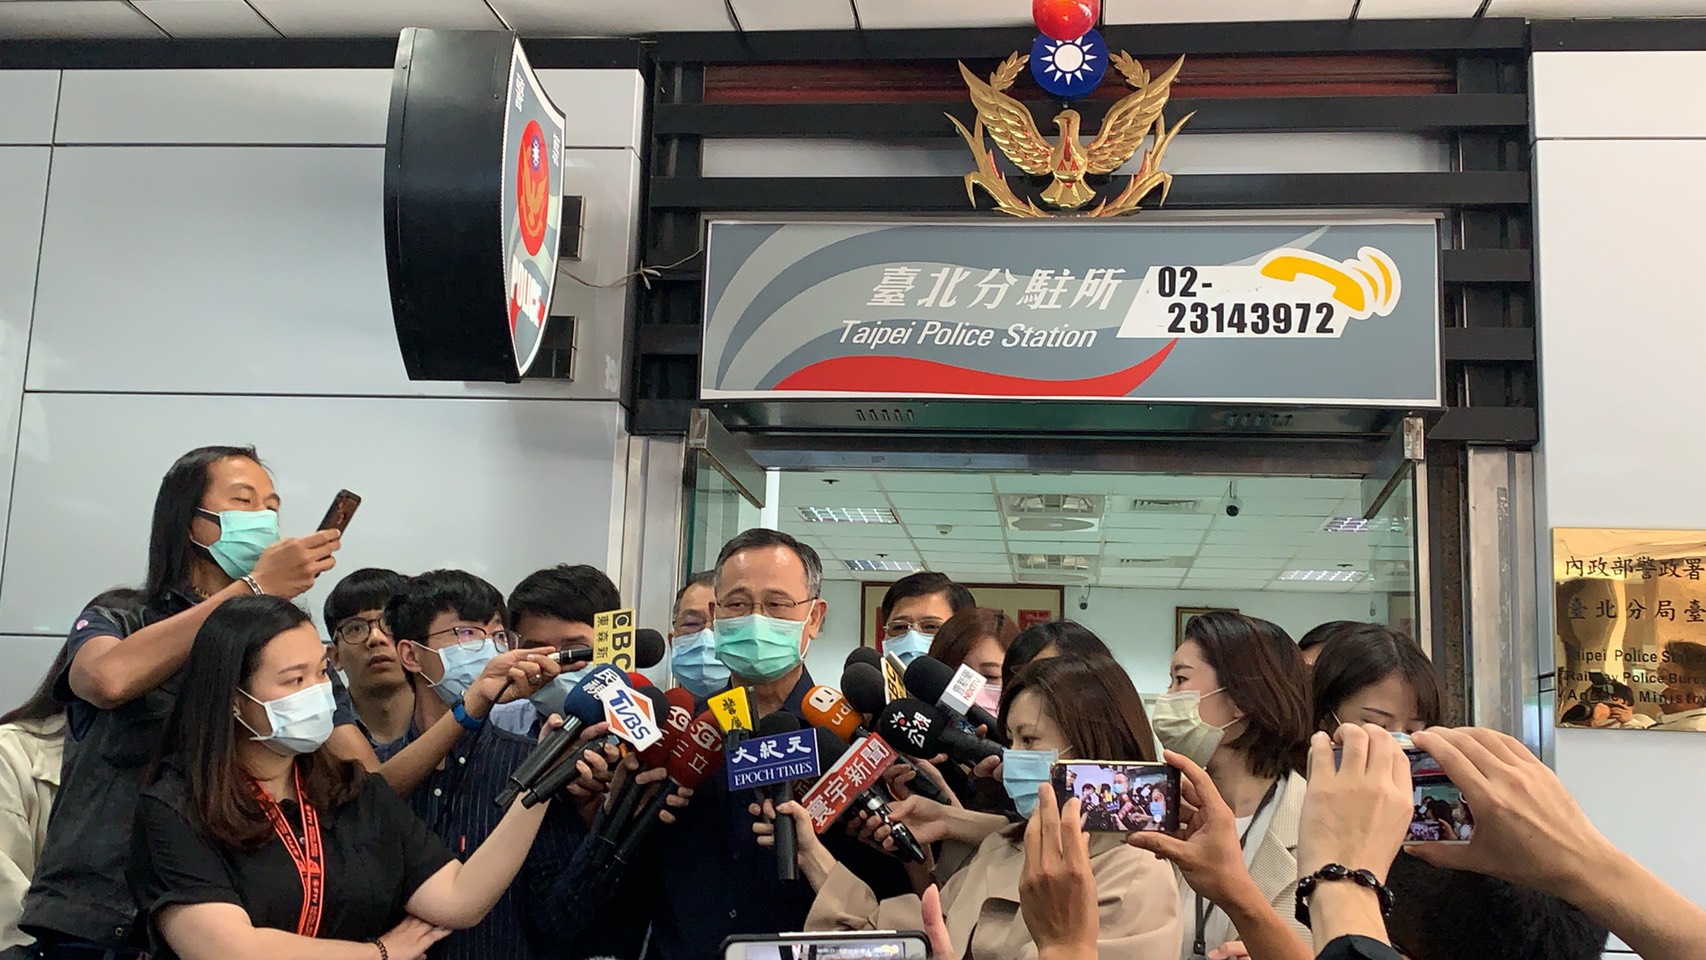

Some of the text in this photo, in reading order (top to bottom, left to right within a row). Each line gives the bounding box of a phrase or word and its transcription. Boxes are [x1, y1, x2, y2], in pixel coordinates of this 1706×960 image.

[510, 255, 542, 327] POLICE
[867, 266, 1126, 311] 臺北分駐所
[1158, 266, 1212, 297] 02-
[1167, 302, 1335, 334] 23143972
[839, 320, 1098, 349] Taipei Police Station
[596, 615, 609, 666] 東森新
[1615, 649, 1658, 663] Police
[1623, 671, 1665, 684] Police
[609, 689, 652, 740] TVBS
[732, 735, 811, 764] 大紀元
[734, 761, 813, 787] EPOCH TIMES
